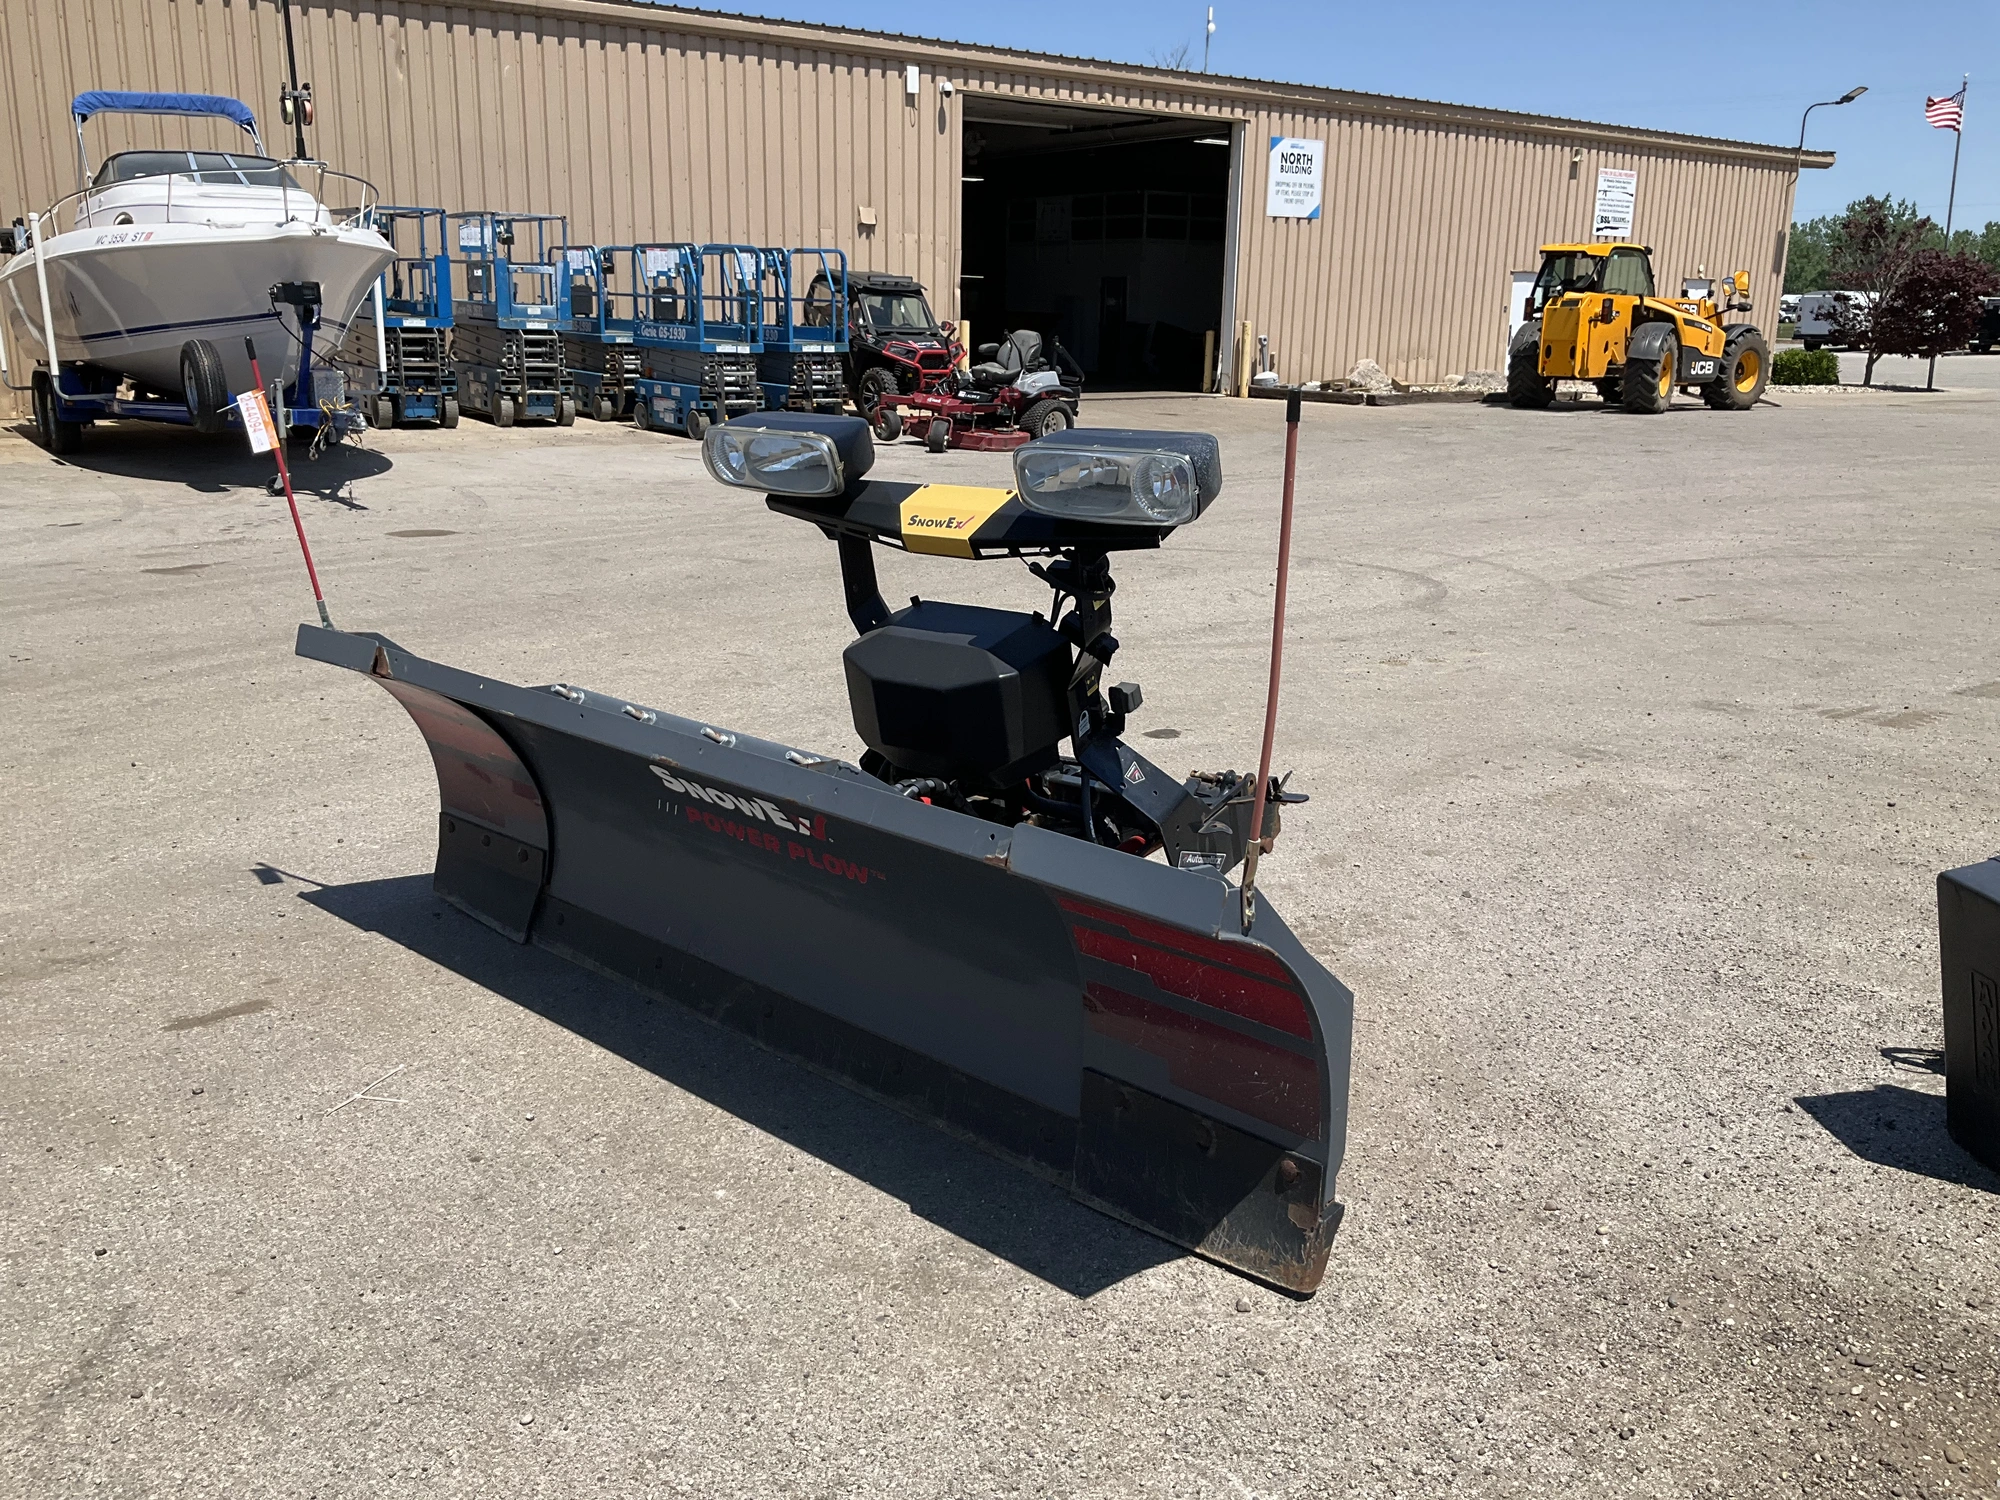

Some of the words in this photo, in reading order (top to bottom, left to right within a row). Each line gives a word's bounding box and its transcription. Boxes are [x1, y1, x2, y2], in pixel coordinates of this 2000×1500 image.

[1280, 152, 1313, 166] NORTH
[1280, 165, 1312, 175] BUILDING
[131, 231, 146, 242] ST
[659, 326, 687, 340] GS-1930
[1691, 361, 1714, 375] JCB
[240, 395, 263, 433] 2-44094
[685, 805, 781, 854] POWER
[787, 840, 868, 884] PLOW
